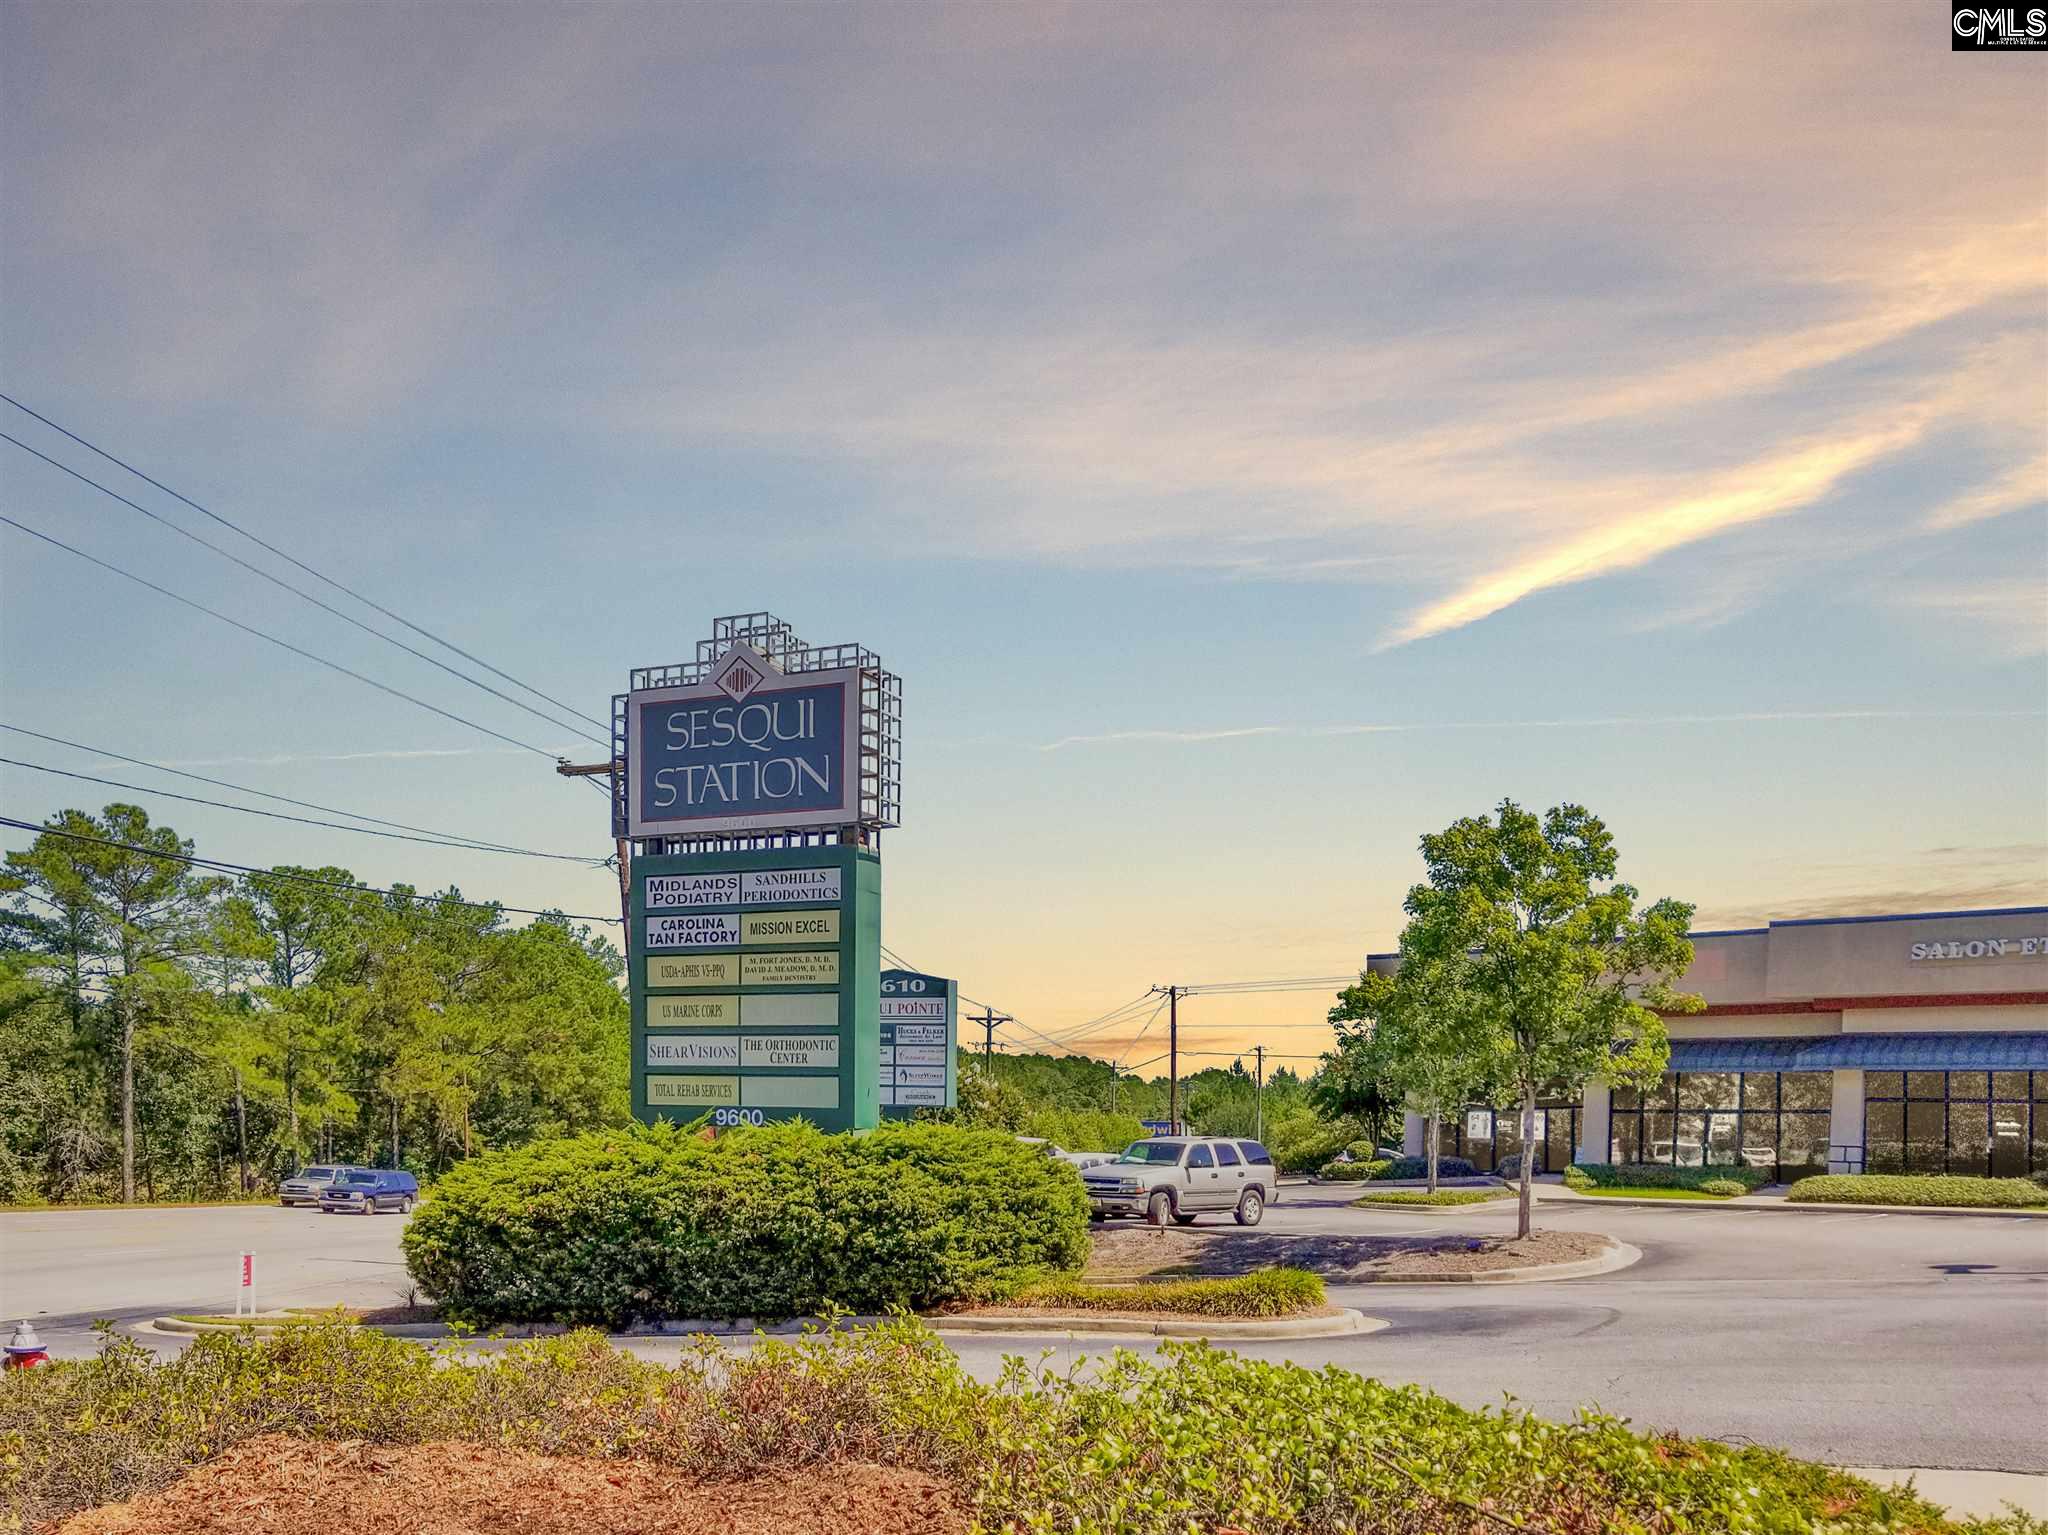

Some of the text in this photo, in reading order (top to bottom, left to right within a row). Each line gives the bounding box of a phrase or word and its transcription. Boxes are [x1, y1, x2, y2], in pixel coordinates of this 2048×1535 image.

[666, 699, 815, 751] SESQUI
[654, 754, 830, 807] STATION
[650, 878, 738, 892] MIDLANDS
[755, 872, 826, 886] SANDHILLS
[653, 891, 733, 905] PODIATRY
[744, 887, 839, 902] PERIODONTICS
[661, 918, 725, 931] CAROLINA
[750, 919, 830, 936] MISSION EXCEL
[649, 930, 738, 945] TAN FACTORY
[1911, 939, 2008, 960] SALON
[745, 966, 766, 974] DAVID
[662, 1004, 723, 1018] US MARINE CORPS
[744, 1038, 836, 1051] THE ORTHODONTIC
[770, 1051, 808, 1064] CENTER
[654, 1083, 732, 1098] TOTAL REHAB SERVICES
[715, 1108, 763, 1126] 9600
